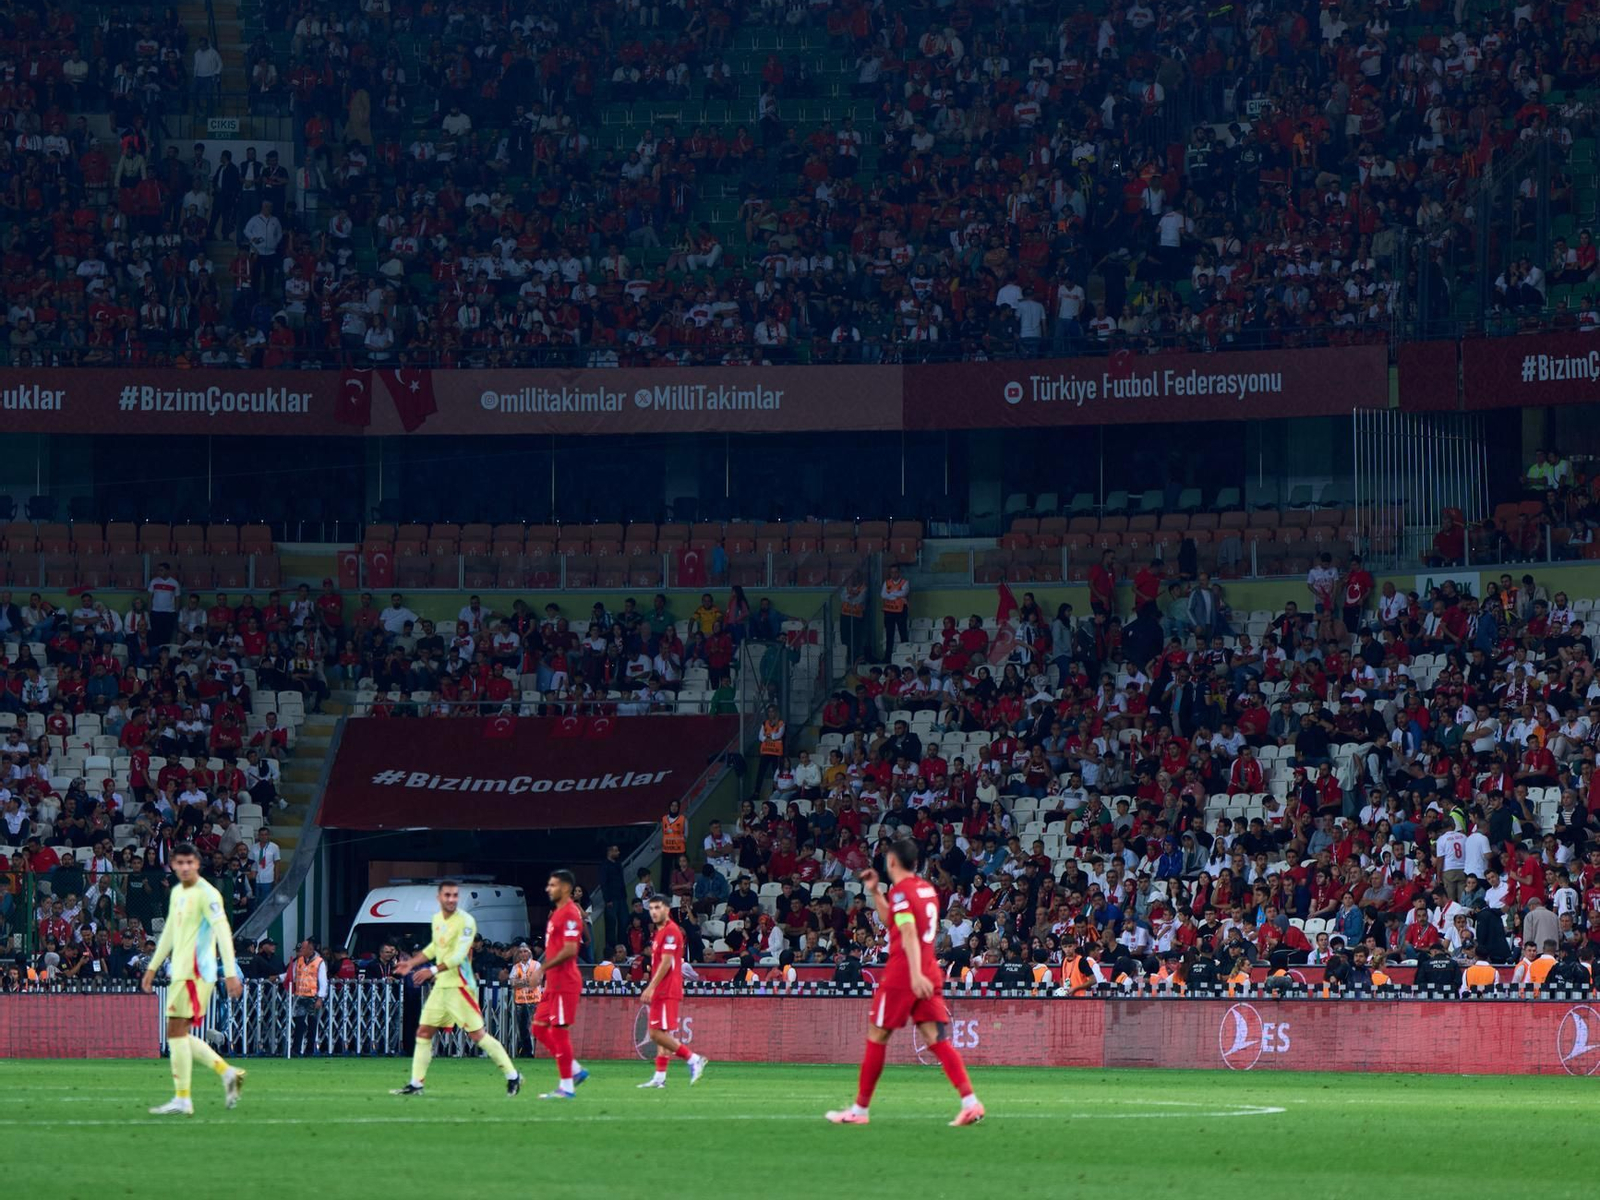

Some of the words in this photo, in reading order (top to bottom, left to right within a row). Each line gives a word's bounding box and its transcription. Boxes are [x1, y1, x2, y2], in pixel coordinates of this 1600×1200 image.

[0, 383, 67, 410] uklar
[118, 385, 313, 416] #BizimÇocuklar
[1030, 374, 1097, 406] Türkiye
[1103, 370, 1159, 399] Futbol
[1164, 367, 1282, 400] Federasyonu
[372, 769, 673, 794] #BizimÇocuklar
[1453, 841, 1463, 859] 8
[952, 1019, 979, 1048] ES
[1261, 1022, 1291, 1052] ES
